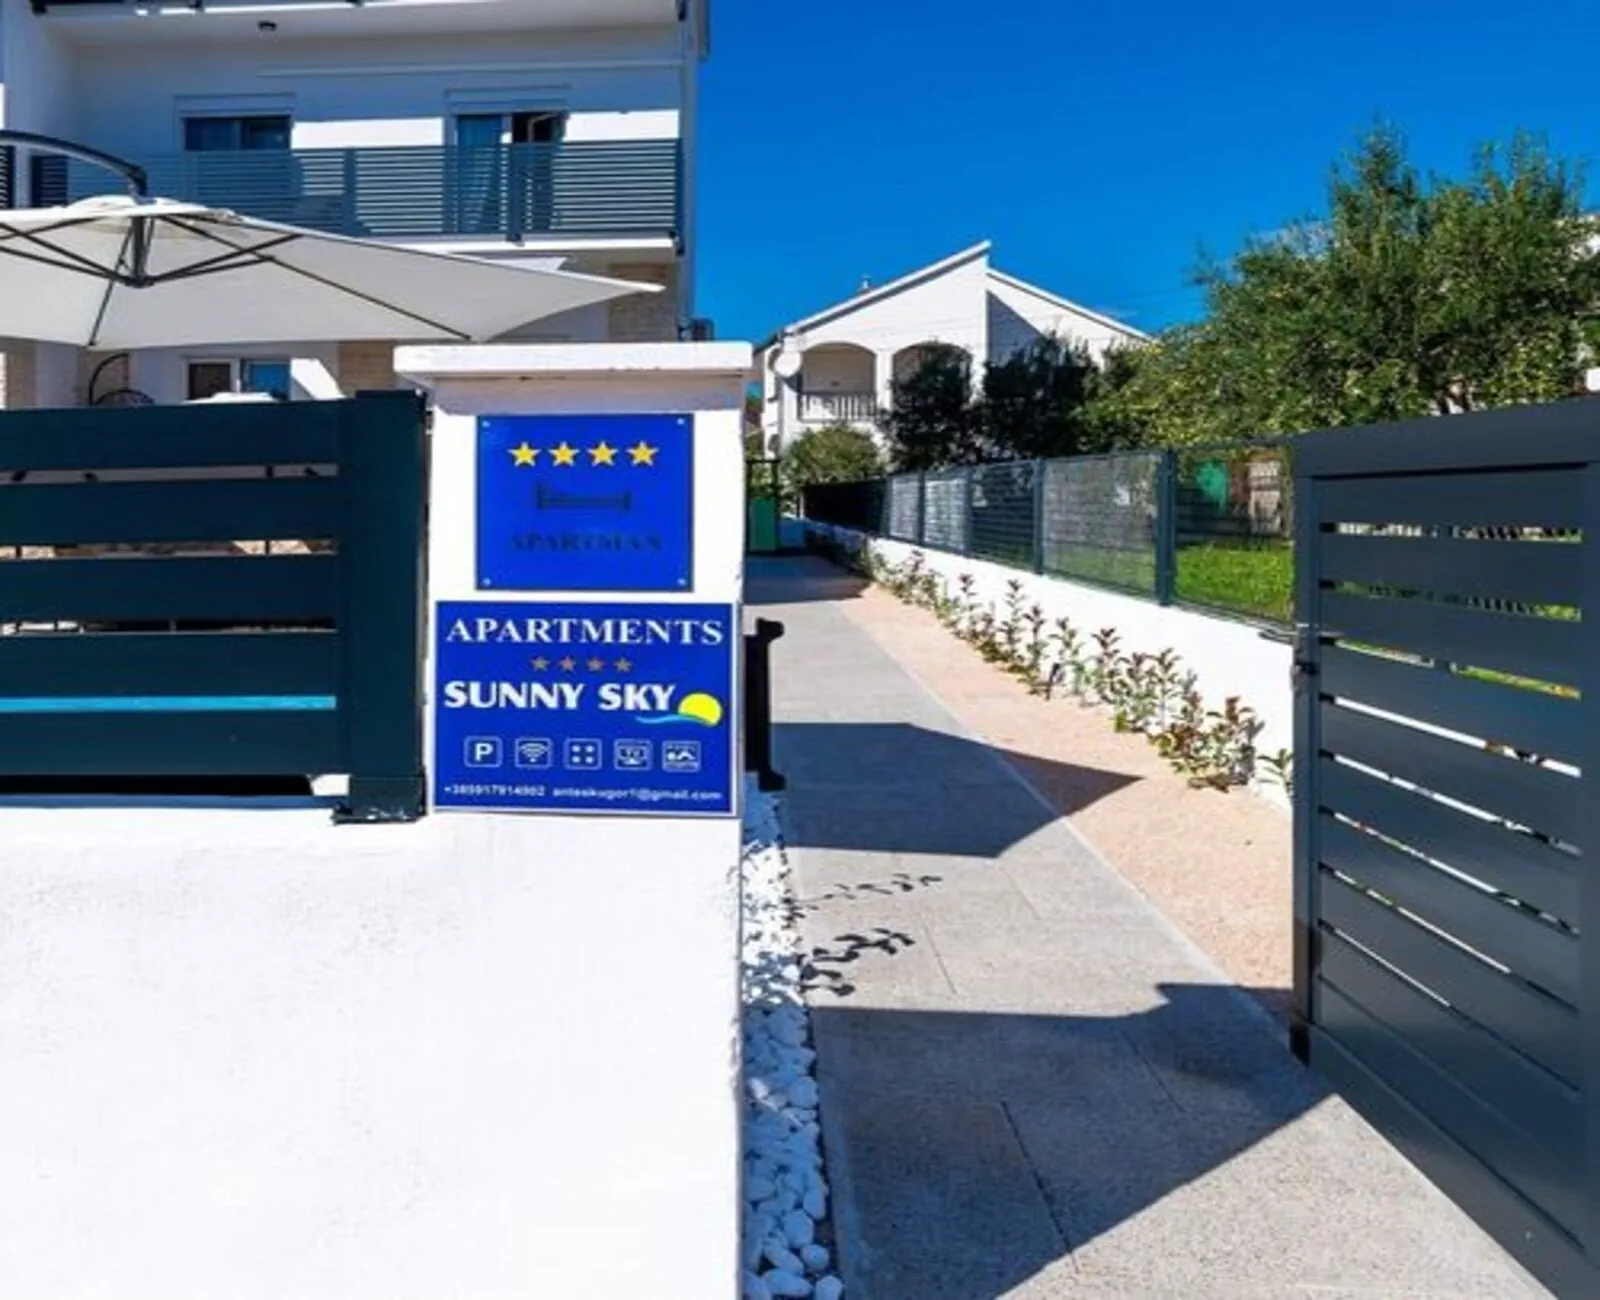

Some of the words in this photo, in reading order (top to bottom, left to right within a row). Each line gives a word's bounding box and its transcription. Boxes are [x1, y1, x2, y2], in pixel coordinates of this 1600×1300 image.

[510, 531, 663, 551] APARTMAN
[445, 617, 725, 646] APARTMENTS
[443, 680, 585, 709] SUNNY
[597, 682, 677, 711] SKY
[474, 742, 494, 762] P
